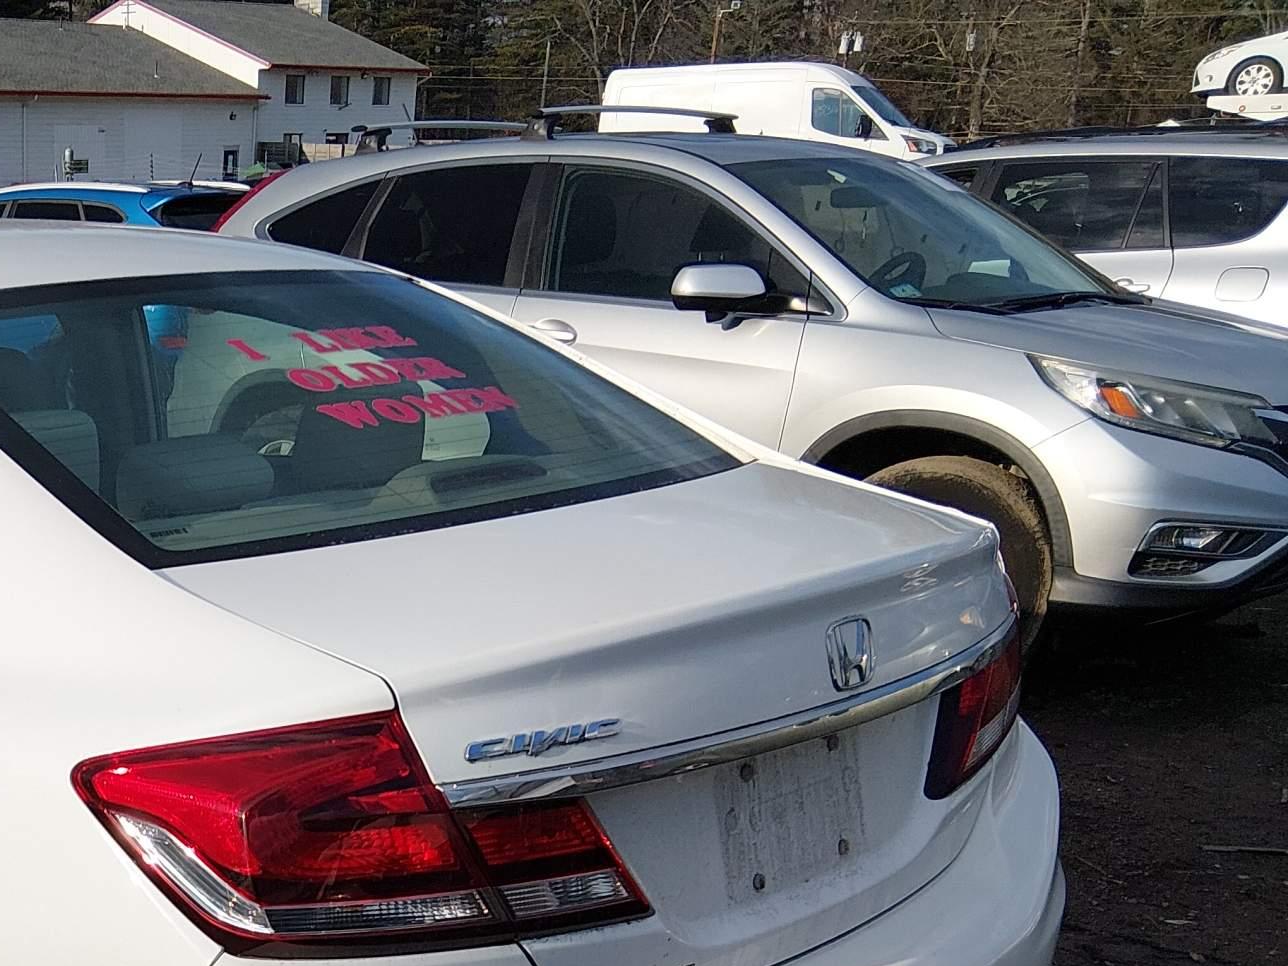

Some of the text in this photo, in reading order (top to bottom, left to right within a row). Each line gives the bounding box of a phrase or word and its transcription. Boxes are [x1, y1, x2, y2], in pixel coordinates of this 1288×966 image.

[227, 325, 418, 361] I LIKE
[287, 357, 466, 392] OLDER
[316, 386, 519, 429] WOMEN
[464, 718, 622, 763] CIVIC
